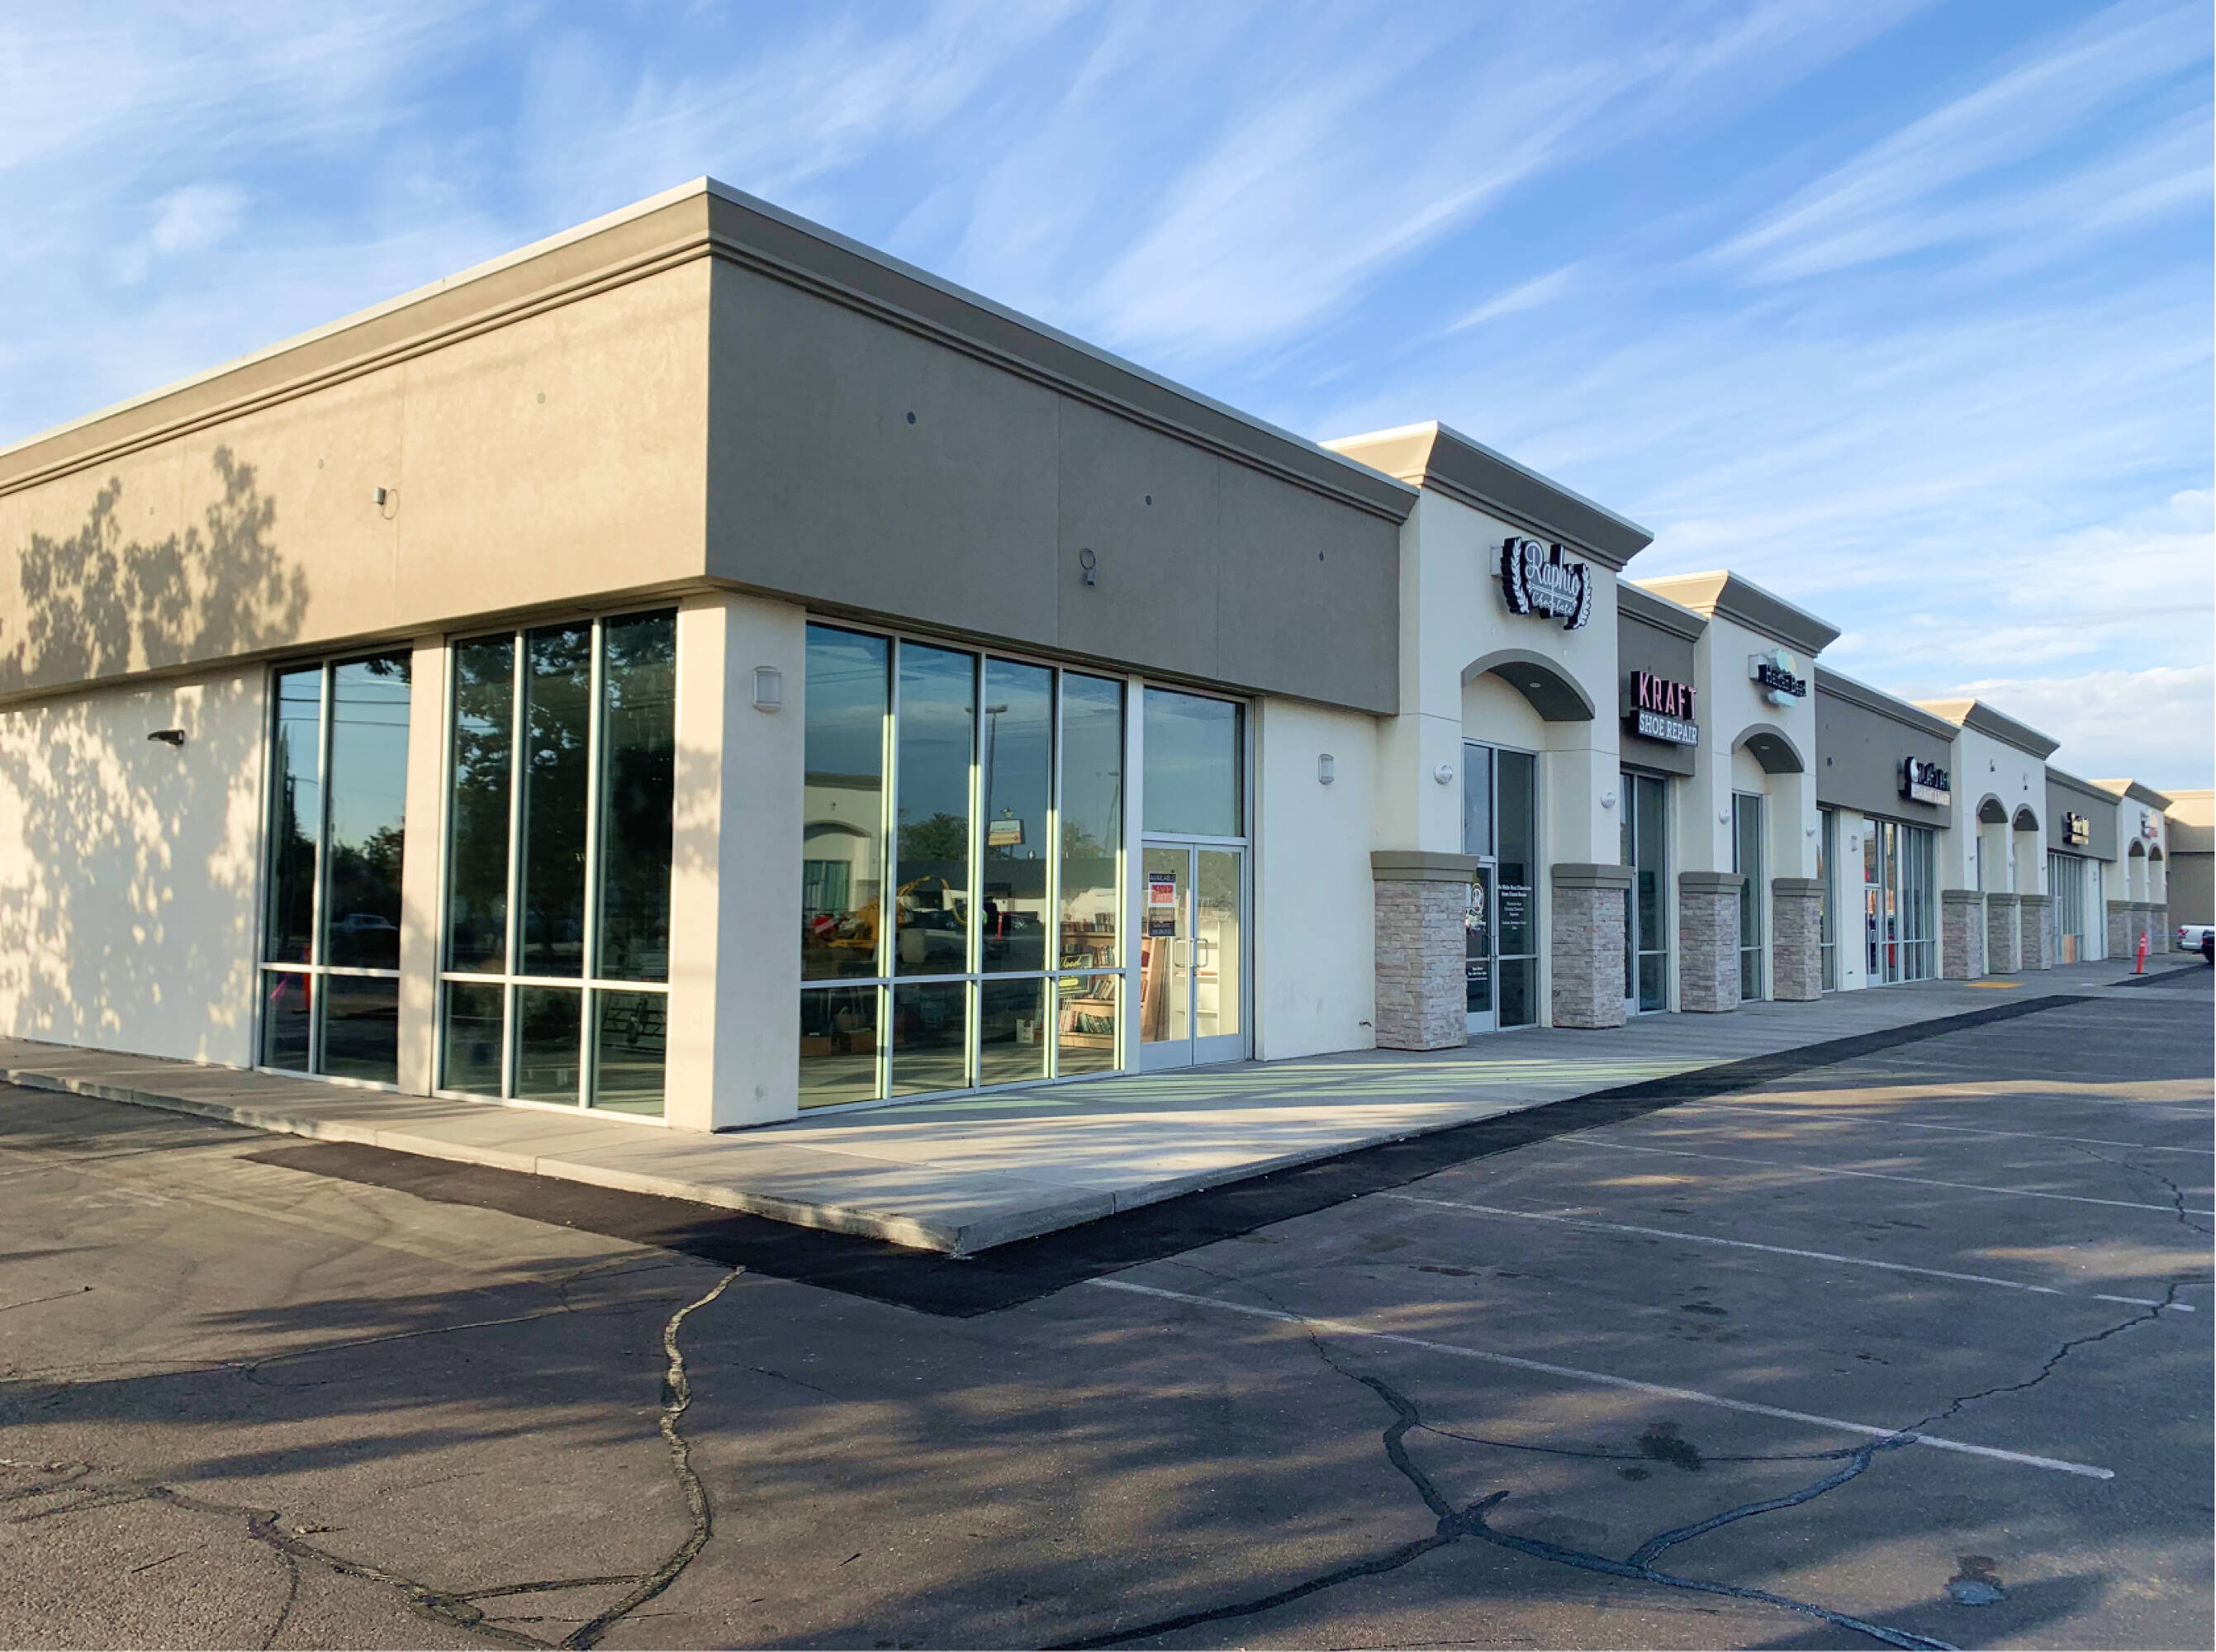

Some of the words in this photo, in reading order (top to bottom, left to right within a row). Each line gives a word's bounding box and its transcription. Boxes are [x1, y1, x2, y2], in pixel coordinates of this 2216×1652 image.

[1639, 671, 1697, 720] KRAFT
[1639, 713, 1664, 738] SHOE
[1666, 720, 1697, 744] REPAIR
